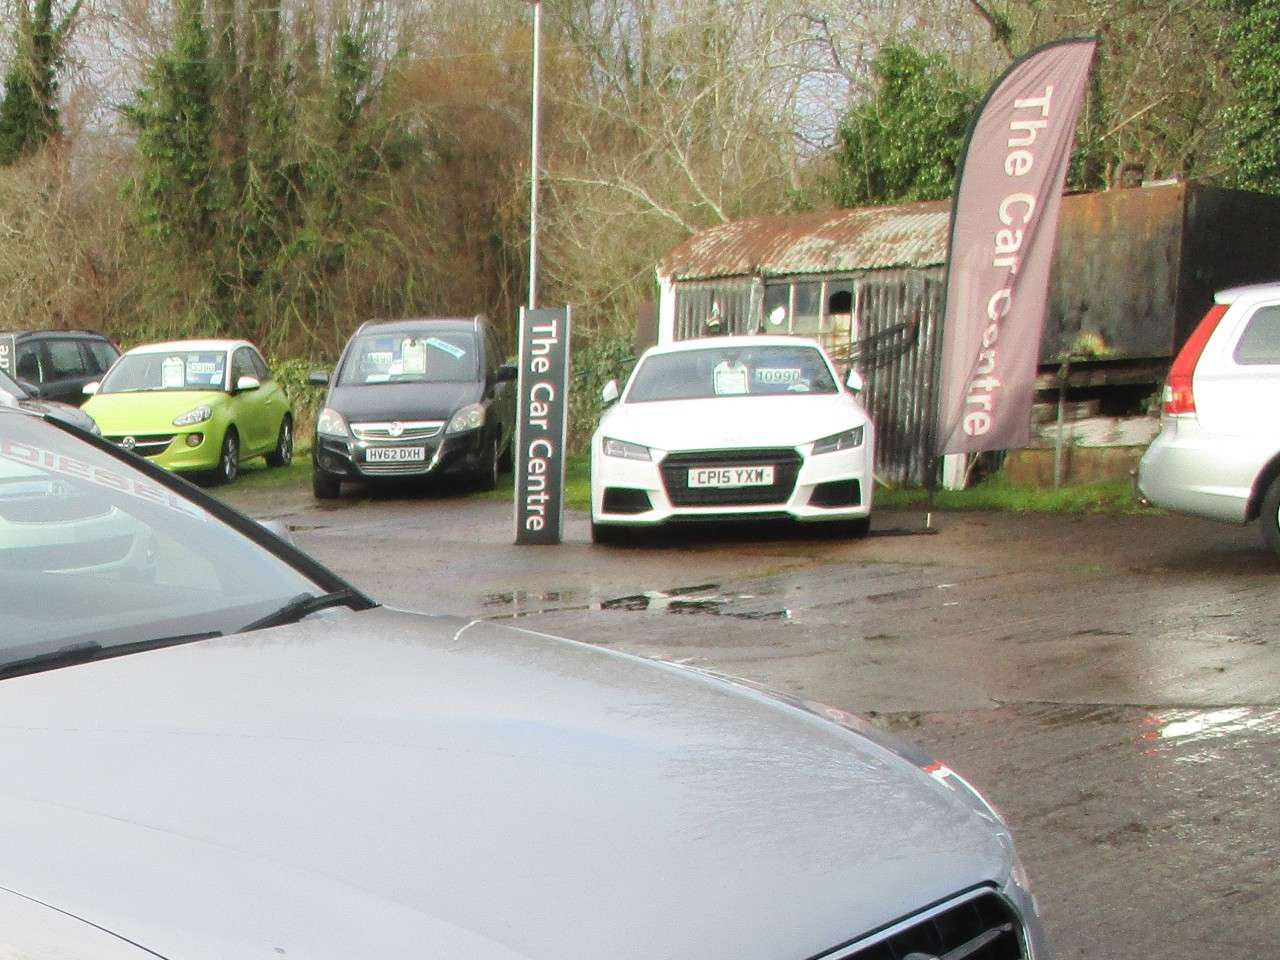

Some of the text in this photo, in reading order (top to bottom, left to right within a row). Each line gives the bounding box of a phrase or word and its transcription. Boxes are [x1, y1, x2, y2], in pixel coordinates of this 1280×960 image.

[963, 86, 1054, 437] The Car Centre
[369, 450, 397, 460] HV62
[526, 319, 558, 532] The Car Centre
[697, 468, 764, 484] CP15 YXW
